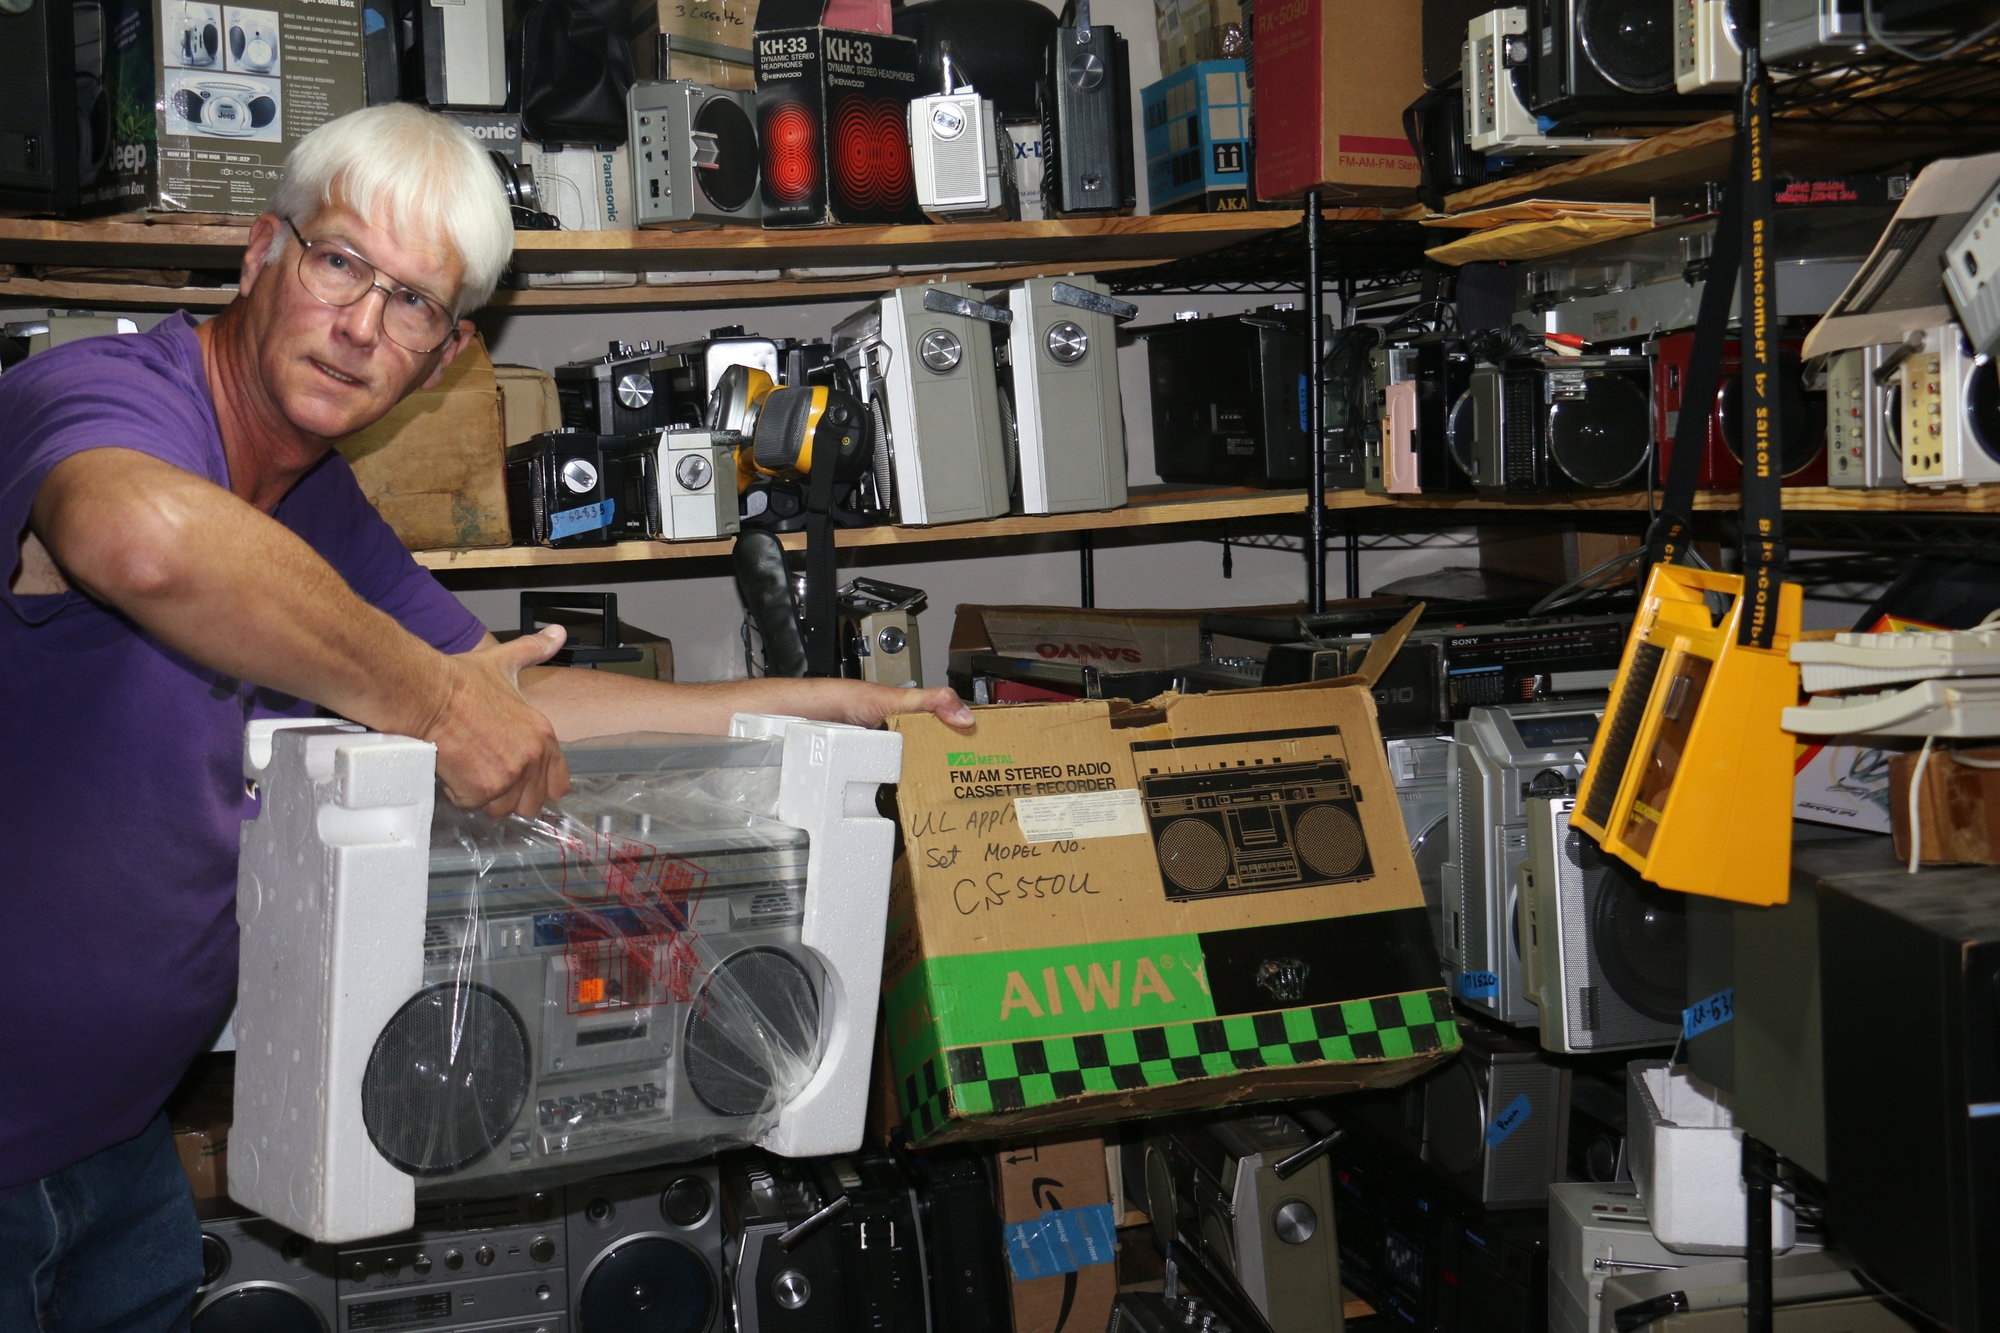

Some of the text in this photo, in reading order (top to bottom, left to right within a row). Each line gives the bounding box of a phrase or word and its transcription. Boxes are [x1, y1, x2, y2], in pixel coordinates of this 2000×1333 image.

[340, 0, 355, 8] Box
[675, 5, 686, 17] 3
[759, 36, 807, 55] KH-33
[825, 36, 873, 65] KH-33
[760, 52, 815, 63] DYNAMIC STEREO
[761, 61, 803, 70] HEADPHONES
[768, 71, 802, 79] KENWOOD
[827, 62, 915, 83] DYNAMIC STEREO HEADPHONES
[833, 78, 865, 88] KENWOOD
[218, 111, 235, 120] Jeep
[464, 122, 517, 140] sonic
[109, 139, 146, 173] Jeep
[1014, 141, 1044, 159] X-D
[1751, 115, 1762, 181] salton
[1339, 155, 1395, 169] FM-AM-FM
[131, 182, 145, 194] Box
[602, 154, 617, 223] Panasonic
[1216, 197, 1247, 211] AKA
[1753, 219, 1770, 477] Beachcomber by salton
[1451, 637, 1479, 646] SONY
[1035, 643, 1142, 663] SANYO
[809, 733, 825, 765] R
[976, 753, 1016, 765] METAL
[949, 761, 1112, 784] FM/AM STEREO RADIO
[954, 777, 1116, 799] CASSETTE RECORDER
[926, 840, 1086, 868] Set MODEL No.
[1000, 956, 1176, 1021] AIWA
[1084, 1236, 1098, 1260] Prime
